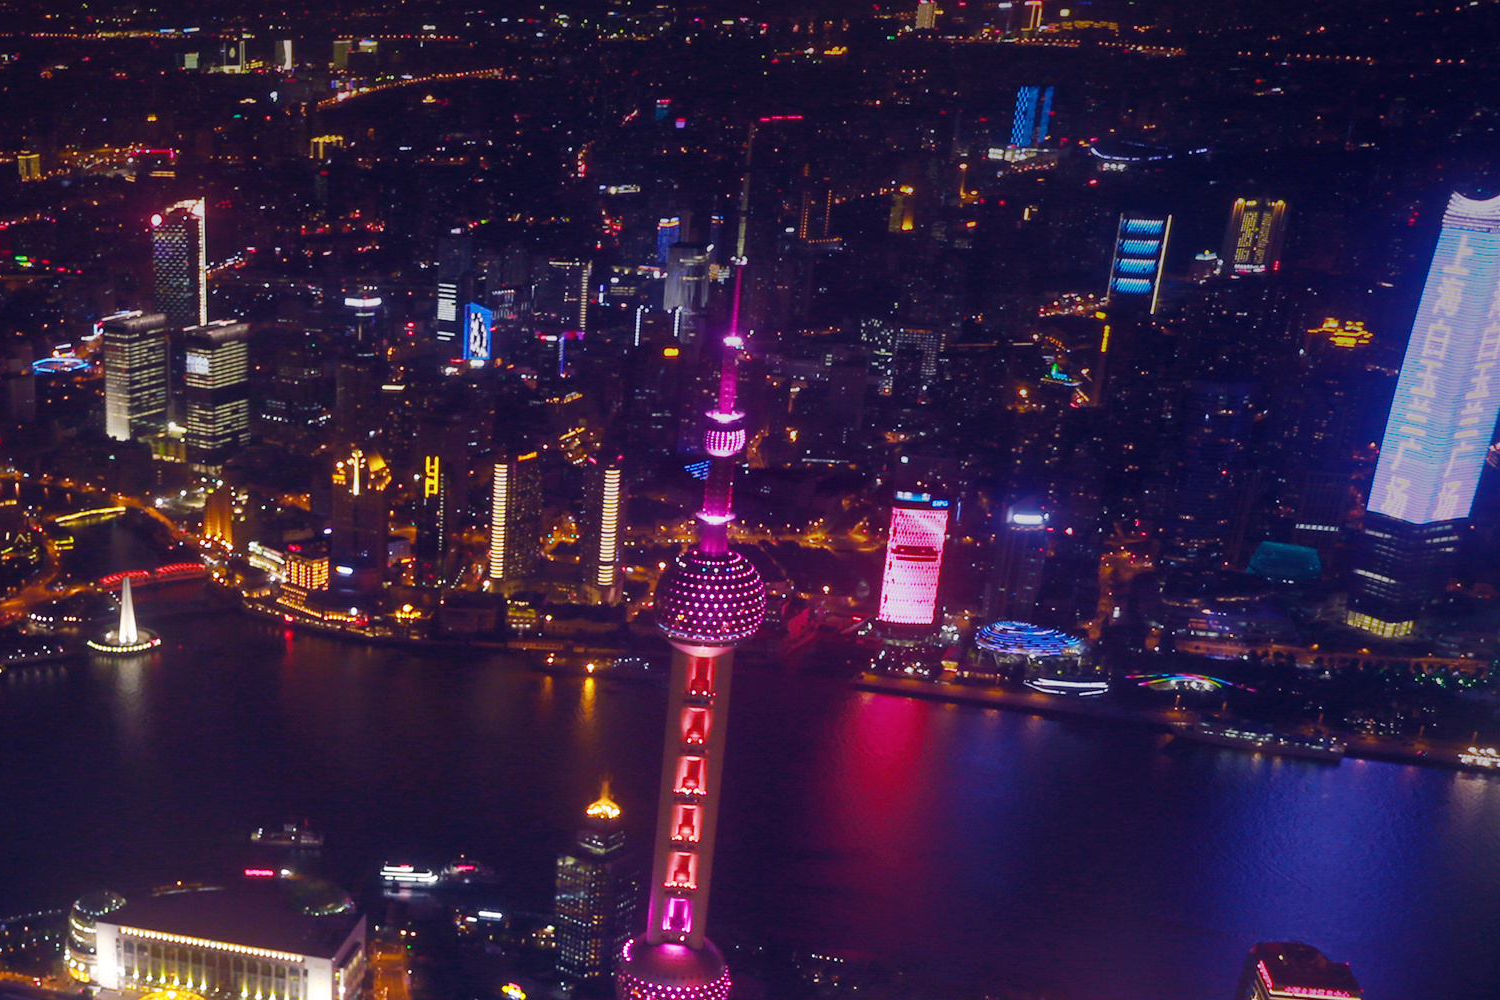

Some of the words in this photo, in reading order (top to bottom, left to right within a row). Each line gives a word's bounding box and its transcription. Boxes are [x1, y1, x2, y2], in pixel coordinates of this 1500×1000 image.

[1379, 233, 1474, 520] 上海白玉兰广场
